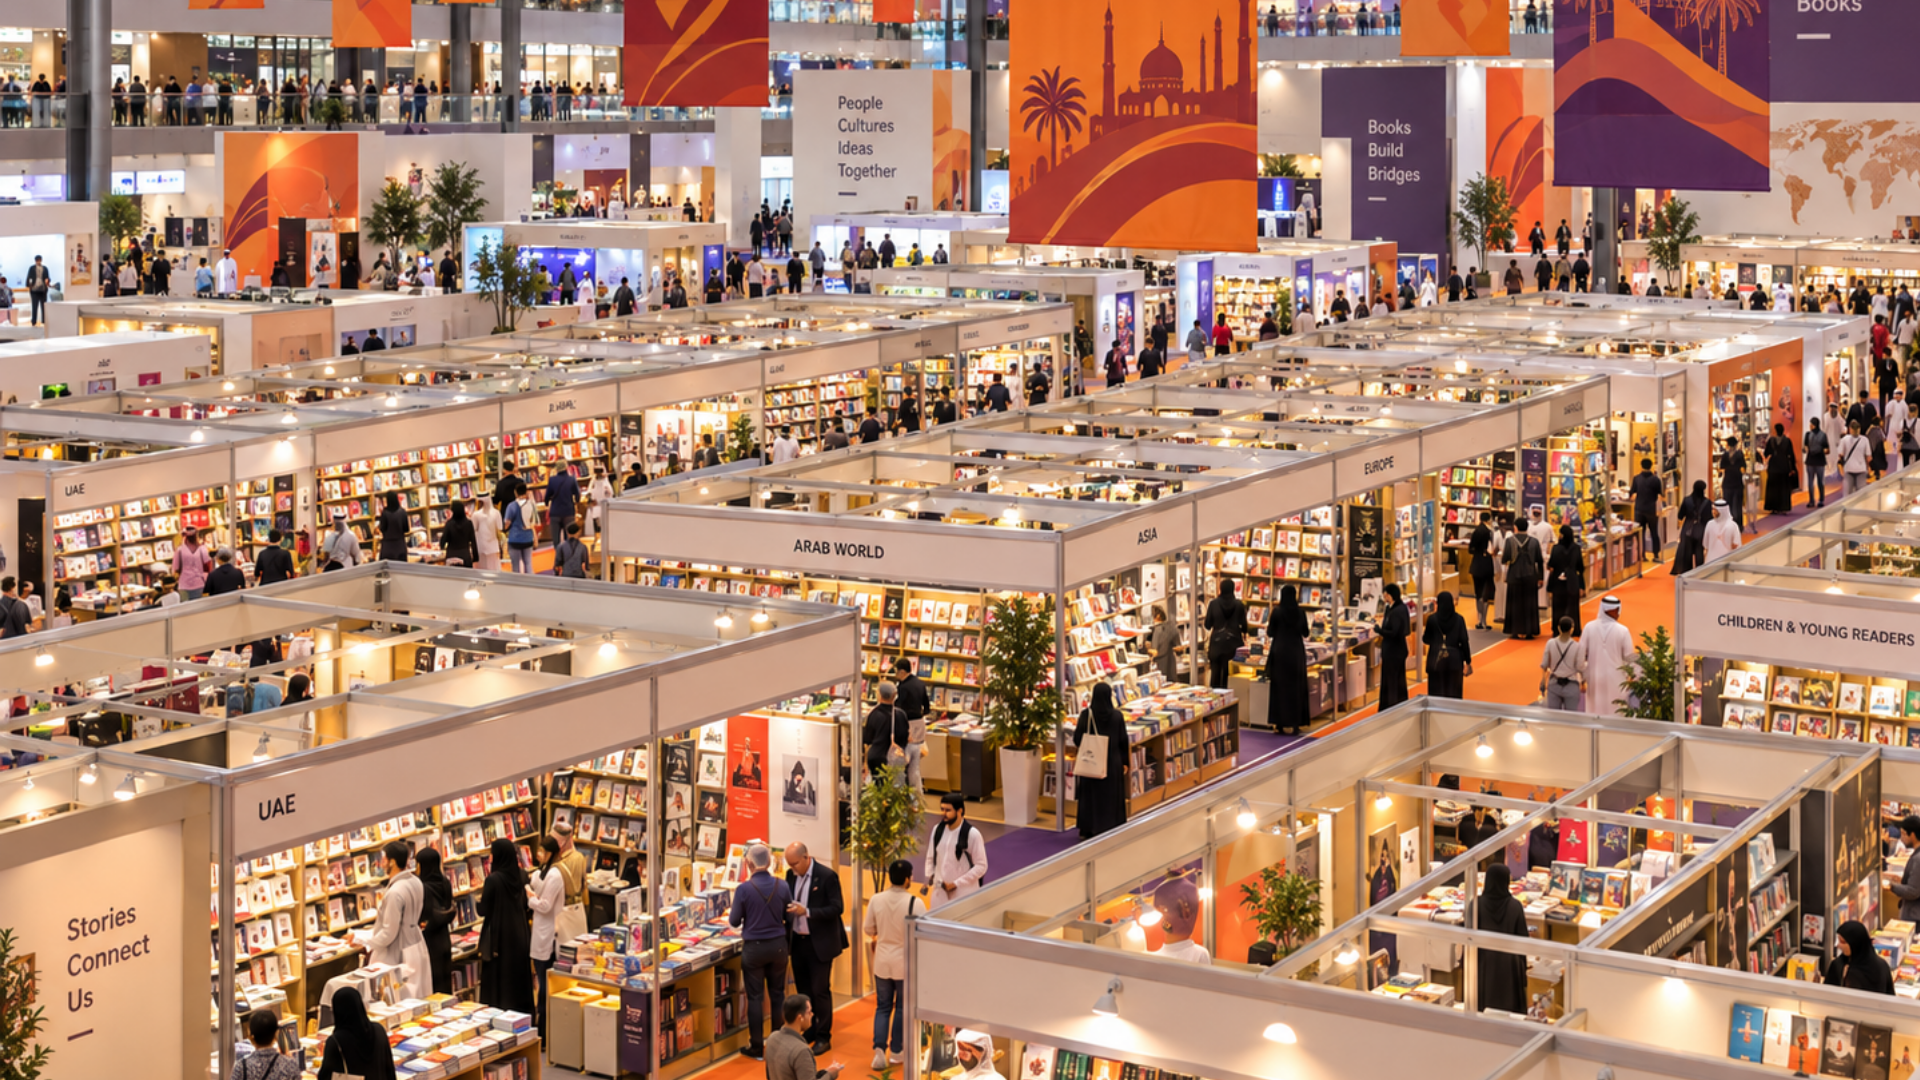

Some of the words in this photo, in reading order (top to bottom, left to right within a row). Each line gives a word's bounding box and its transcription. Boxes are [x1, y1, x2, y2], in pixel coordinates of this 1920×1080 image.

[1797, 0, 1863, 13] Books
[838, 95, 884, 114] People
[837, 117, 895, 133] Cultures
[1368, 118, 1412, 135] Books
[838, 140, 874, 156] Ideas
[1368, 142, 1404, 158] Build
[837, 162, 897, 182] Together
[1368, 165, 1421, 186] Bridges
[1364, 455, 1395, 476] EUROPE
[64, 482, 85, 497] UAE
[1137, 526, 1158, 546] ASIA
[793, 538, 831, 555] ARAB
[833, 542, 885, 559] WORLD
[1717, 613, 1783, 633] CHILDREN
[1785, 620, 1796, 634] &
[1798, 621, 1849, 640] YOUNG
[1852, 627, 1915, 647] READERS
[258, 793, 296, 822] UAE
[67, 906, 137, 942] Stories
[67, 932, 151, 977] Connect
[67, 987, 94, 1013] Us
